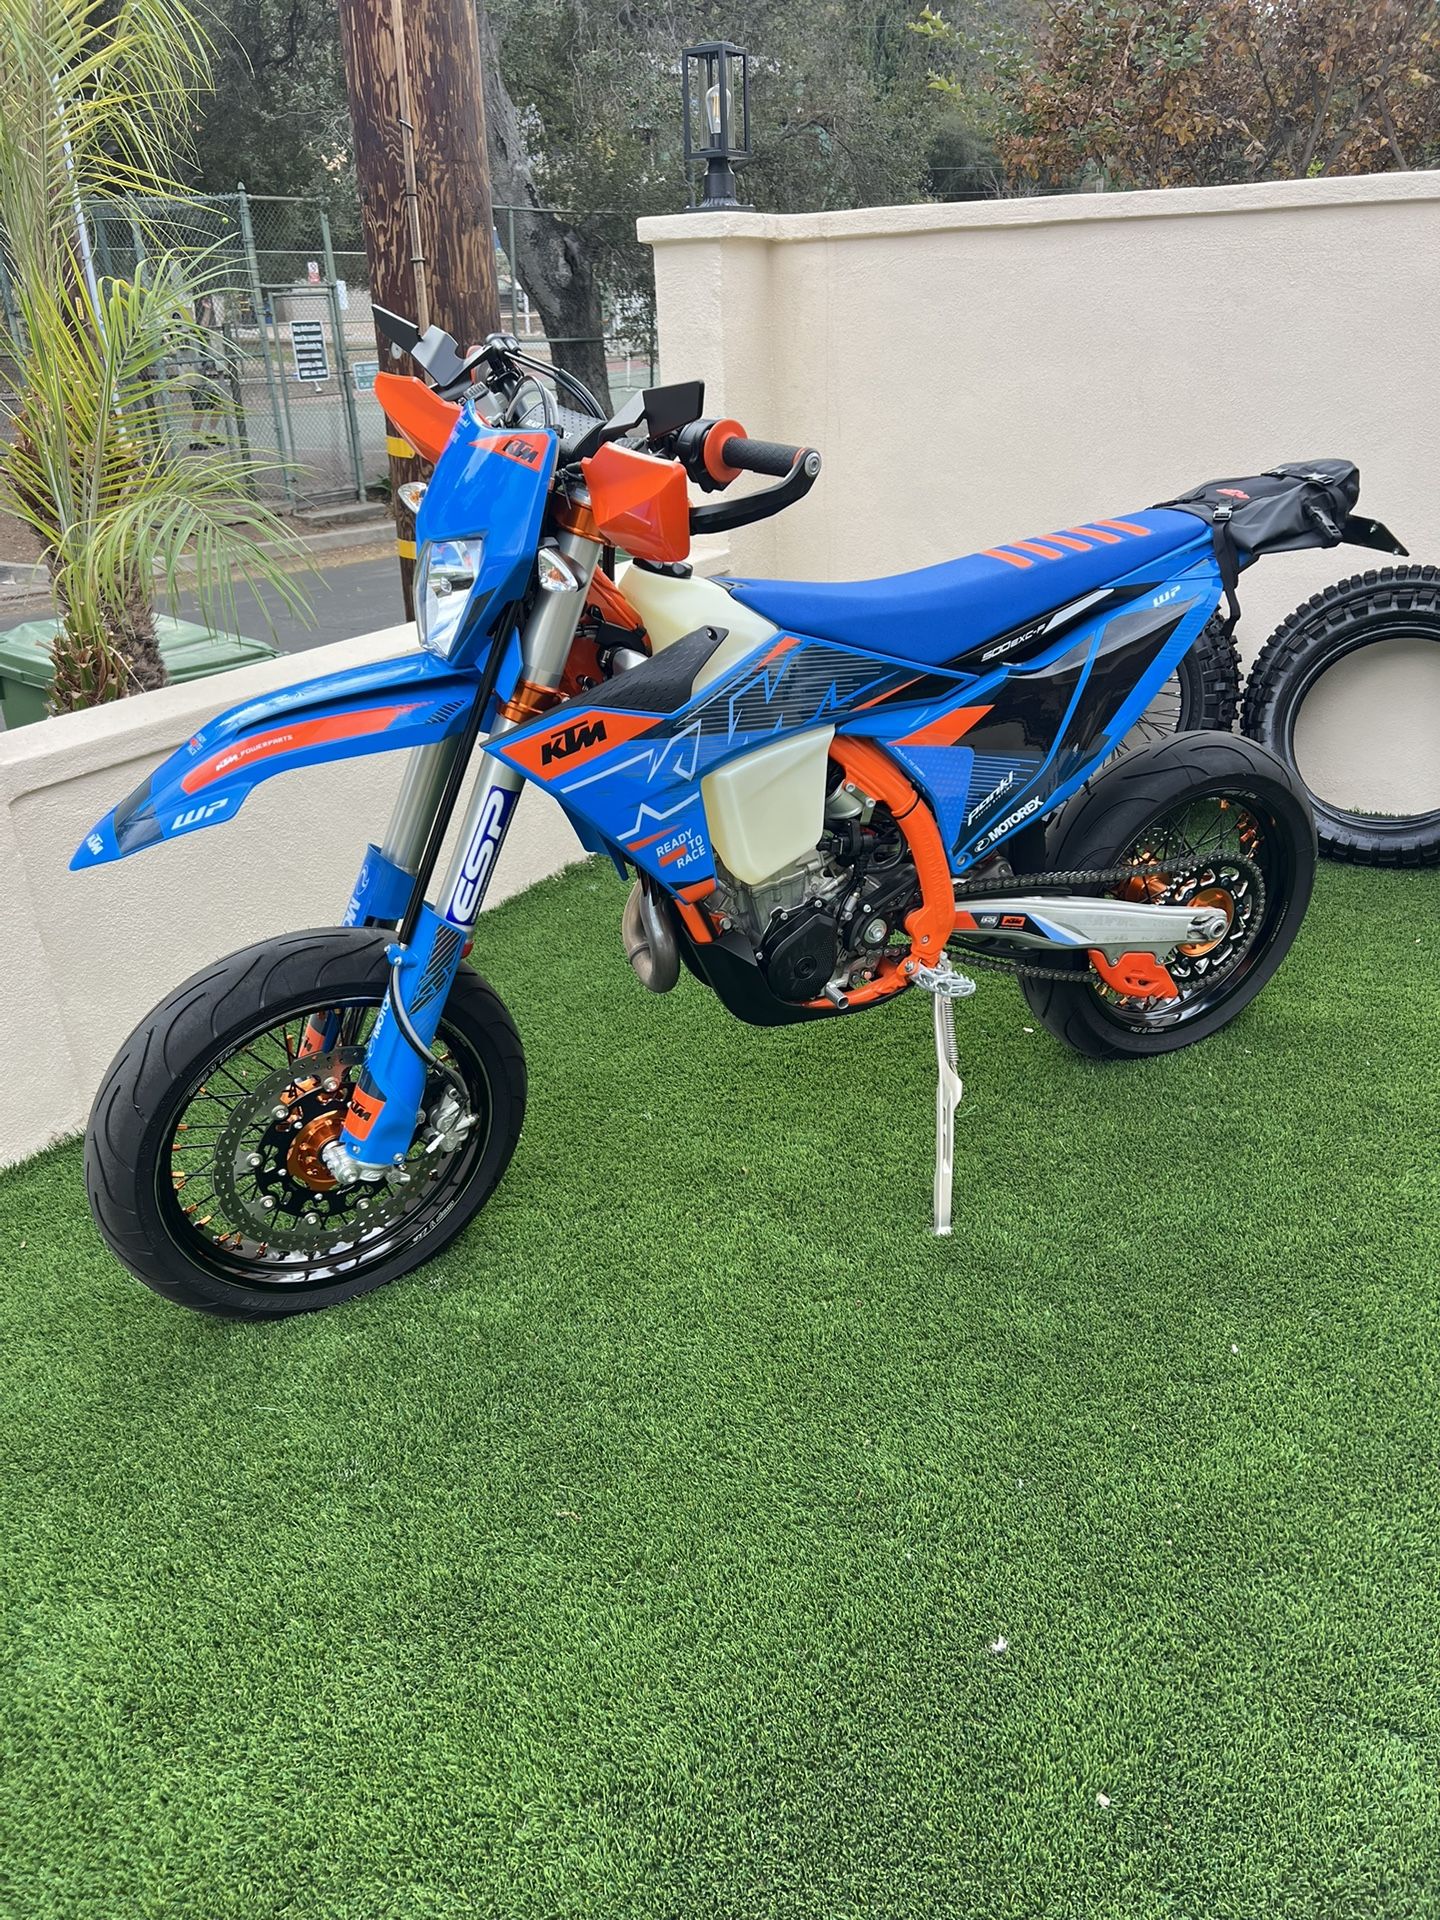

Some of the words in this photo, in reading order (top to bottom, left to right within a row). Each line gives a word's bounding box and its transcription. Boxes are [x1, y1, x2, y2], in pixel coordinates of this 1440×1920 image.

[502, 439, 538, 463] KTM
[541, 719, 607, 766] KTM
[171, 798, 228, 830] WP
[988, 795, 1044, 842] MOTOREX
[86, 832, 104, 855] KTM
[452, 790, 504, 922] ESP
[656, 828, 693, 857] READY
[687, 834, 704, 850] TO
[676, 845, 706, 869] RACE
